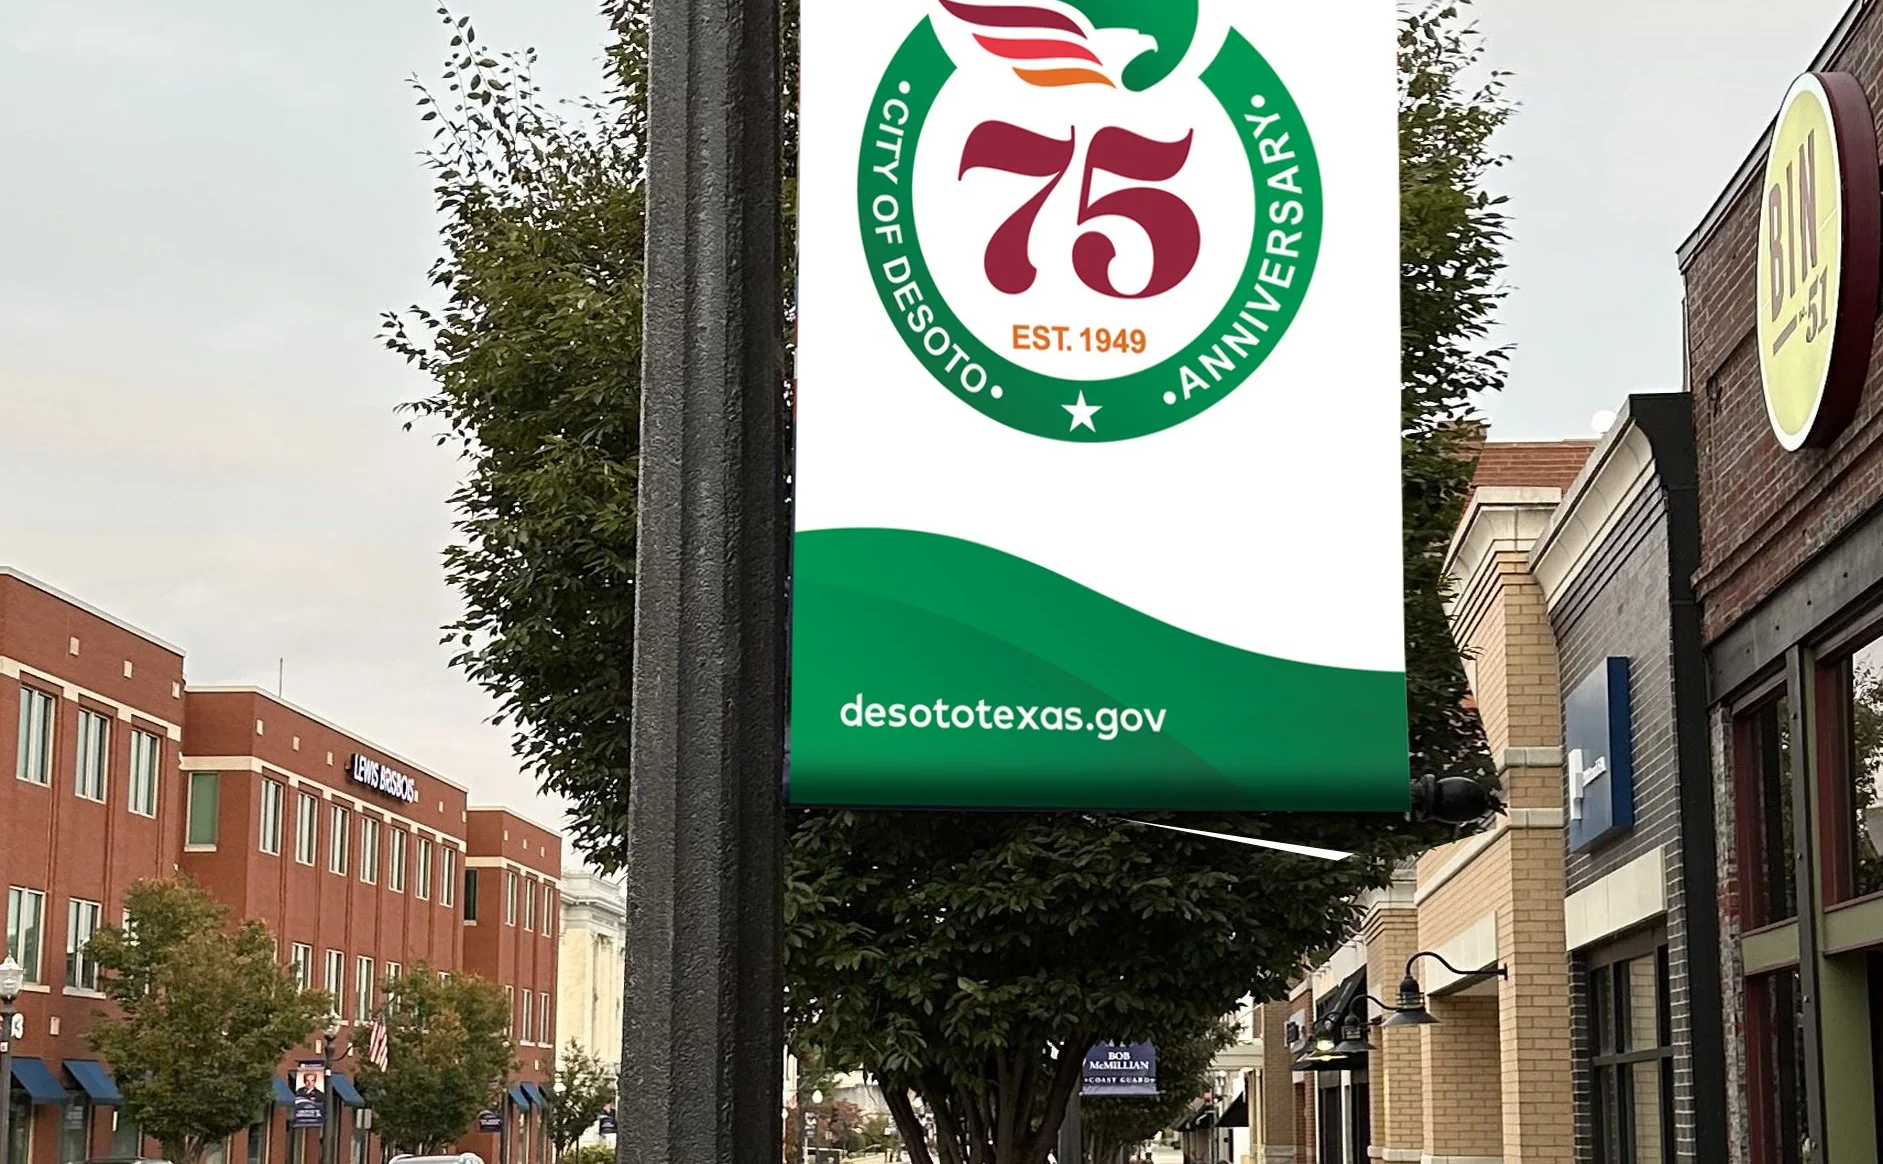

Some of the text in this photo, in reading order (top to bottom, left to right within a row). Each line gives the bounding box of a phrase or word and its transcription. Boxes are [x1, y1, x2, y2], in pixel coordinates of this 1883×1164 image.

[872, 98, 988, 394] CITY OF DESOTO
[957, 119, 1201, 300] 75
[1768, 127, 1818, 323] BIN
[1178, 112, 1305, 401] ANNIVERSARY
[1012, 324, 1147, 354] EST. 1949
[1805, 264, 1829, 344] 51
[840, 693, 1168, 741] desototexas.gov
[1089, 1061, 1150, 1070] McMILLIAN
[1107, 1051, 1131, 1061] BOB
